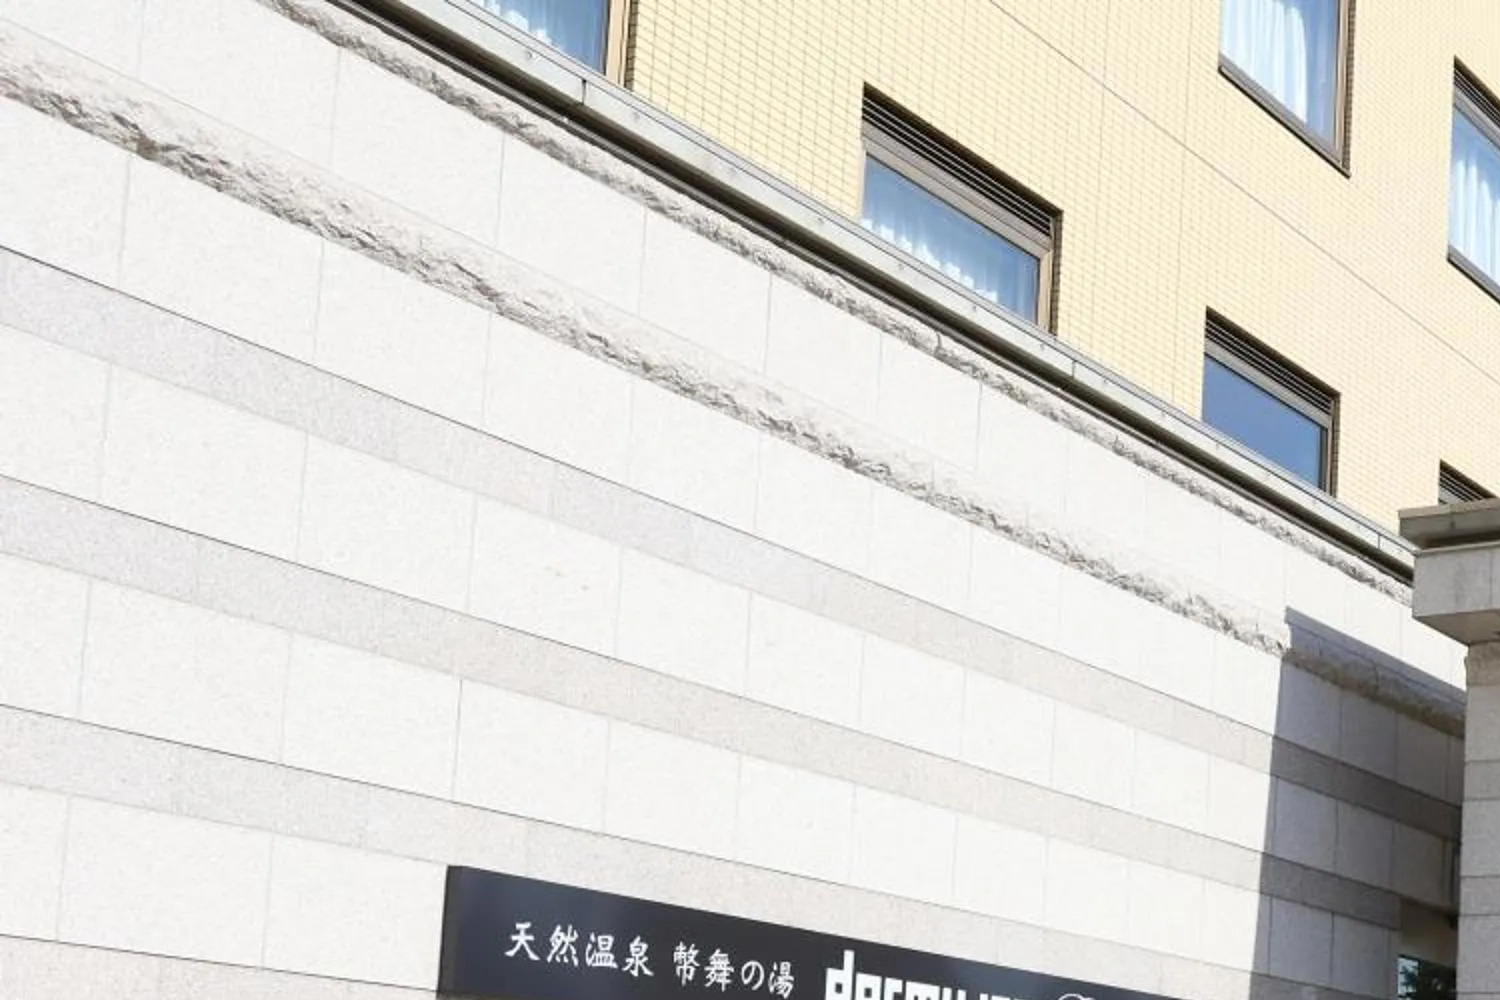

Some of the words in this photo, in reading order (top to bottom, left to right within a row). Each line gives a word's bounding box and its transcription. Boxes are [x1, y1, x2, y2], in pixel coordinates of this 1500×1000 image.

[505, 921, 654, 977] 天然温泉
[673, 940, 795, 999] 幣舞の湯
